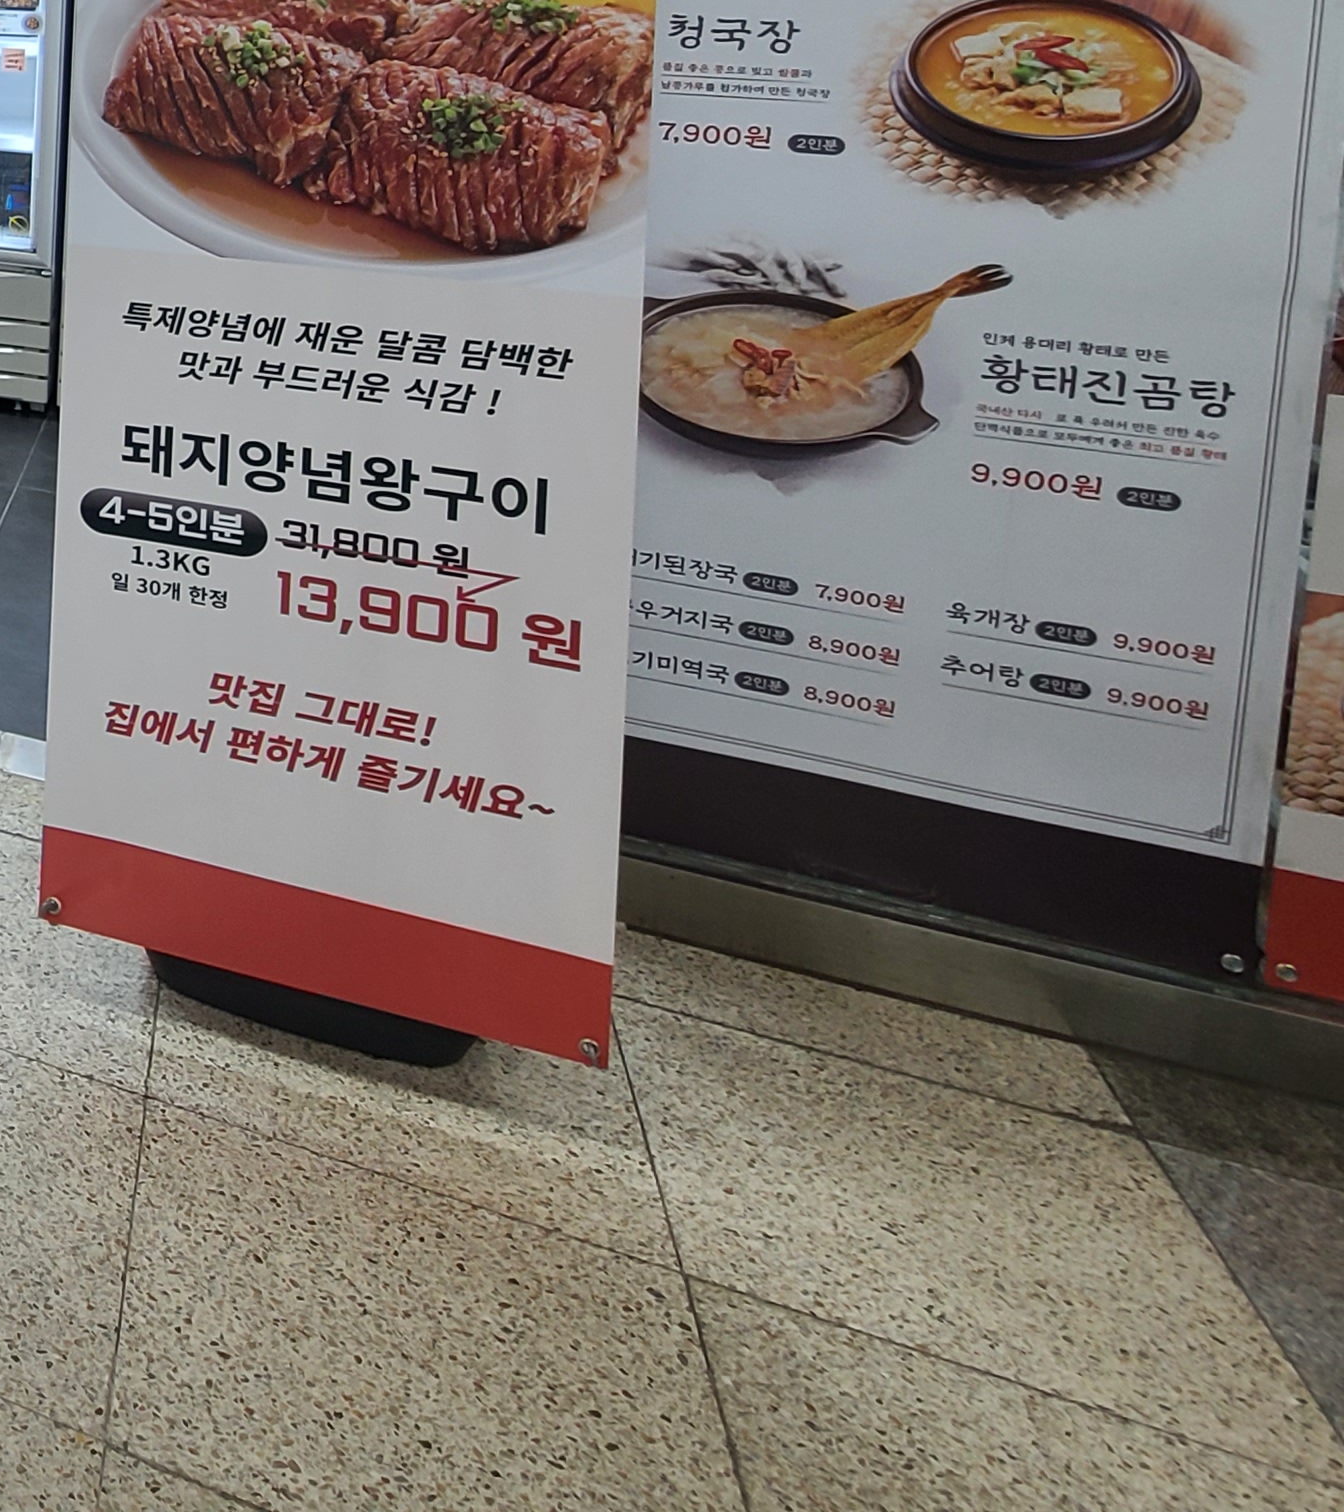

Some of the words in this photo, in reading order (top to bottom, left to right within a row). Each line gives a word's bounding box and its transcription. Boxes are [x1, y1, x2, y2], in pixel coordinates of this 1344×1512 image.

[667, 14, 801, 54] 청국장
[768, 86, 791, 97] 만든
[796, 88, 831, 100] 청국장
[658, 121, 772, 149] 7,900원
[796, 138, 838, 153] 2인분
[121, 301, 287, 350] 특제양념에
[295, 320, 365, 357] 재운
[378, 328, 448, 366] 달콤
[460, 338, 574, 381] 담백한
[1078, 342, 1128, 359] 황태로
[1135, 348, 1170, 364] 만든
[178, 350, 243, 386] 맛과
[253, 358, 390, 404] 부드러운
[403, 378, 476, 416] 식감
[980, 354, 1236, 418] 황태진곰탕
[1132, 422, 1157, 434] 만든
[120, 424, 549, 536] 돼지양념왕구이
[970, 463, 1103, 501] 9,900원
[1126, 491, 1174, 507] 2인분
[98, 495, 246, 546] 4-5인분
[130, 545, 212, 577] 1.3KG
[281, 519, 419, 570] 31,800
[433, 543, 470, 579] 원
[111, 571, 129, 591] 일
[136, 575, 181, 601] 30개
[188, 585, 229, 610] 한정
[751, 575, 793, 592] 2인분
[815, 583, 905, 614] 7,900원
[276, 569, 499, 654] 13,900
[521, 613, 584, 673] 원
[629, 599, 734, 635] 우거지국
[747, 625, 788, 642] 2인분
[808, 635, 900, 667] 8,900원
[945, 601, 1031, 634] 육개장
[1044, 625, 1089, 643] 2인분
[629, 650, 729, 685] 기미역국
[742, 675, 782, 692] 2인분
[803, 686, 896, 718] 8,900원
[940, 654, 1024, 688] 추어탕
[1038, 677, 1084, 696] 2인분
[208, 672, 286, 718] 맛집
[295, 691, 438, 747] 그대로!
[104, 700, 215, 754] 집에서
[226, 727, 346, 783] 편하게
[356, 753, 556, 820] 즐기세요~
